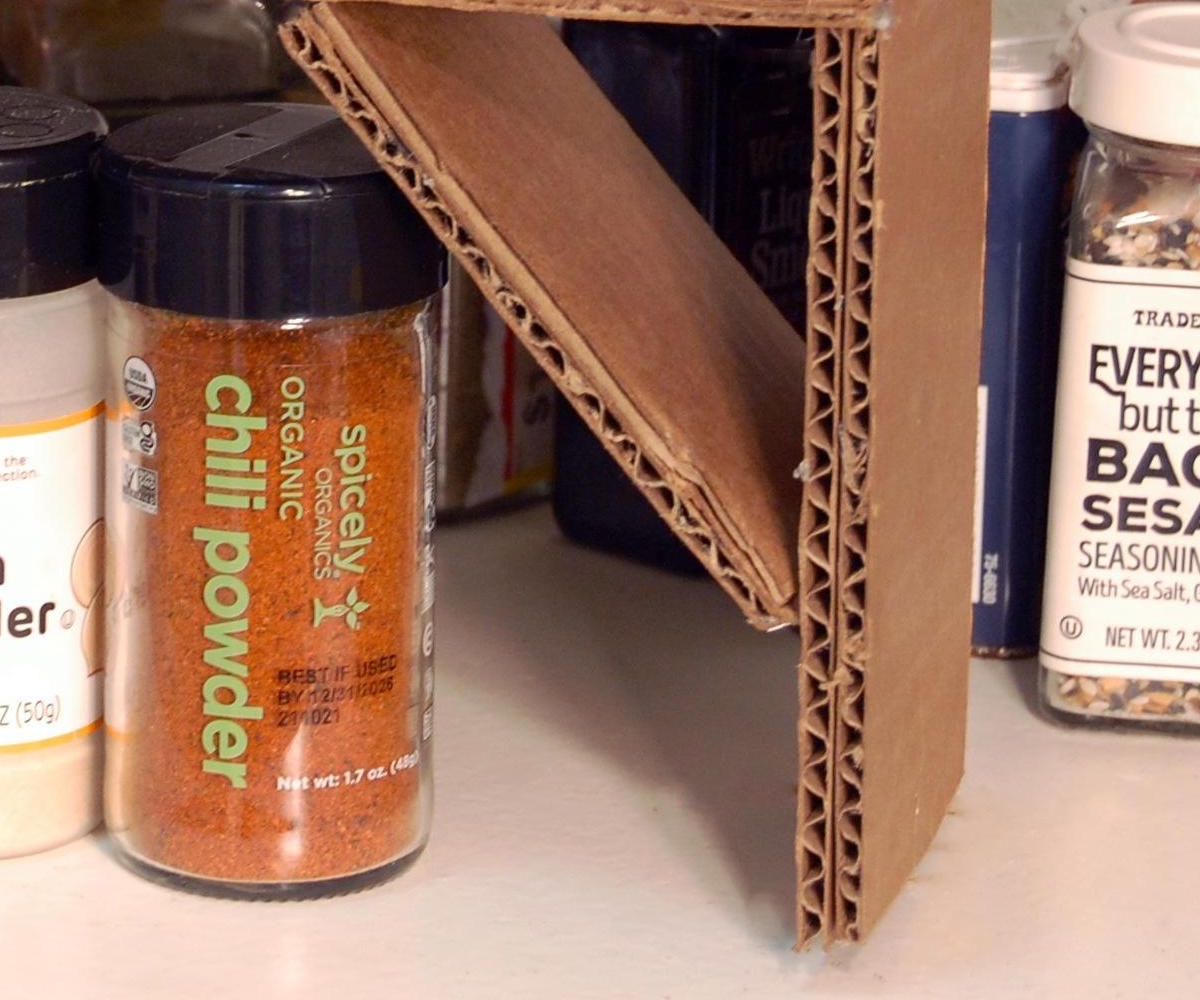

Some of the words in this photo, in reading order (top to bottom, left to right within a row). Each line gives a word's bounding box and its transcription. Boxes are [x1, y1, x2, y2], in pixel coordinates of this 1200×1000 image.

[1134, 310, 1200, 329] TRADE
[1119, 391, 1180, 434] but
[204, 374, 268, 511] chili
[278, 375, 306, 521] ORGANIC
[4, 455, 27, 467] the
[332, 423, 367, 574] spicely
[313, 467, 333, 581] ORGANICS
[1078, 576, 1118, 598] With
[1121, 579, 1150, 599] Sea
[1154, 580, 1191, 605] Salt,
[1105, 626, 1136, 648] NET
[1141, 628, 1171, 650] WT.
[193, 525, 264, 789] powder
[278, 667, 329, 684] BEST
[335, 666, 350, 681] IF
[356, 654, 397, 677] USED
[16, 696, 61, 728] (50g)
[277, 690, 303, 705] BY
[277, 776, 309, 791] Net
[314, 773, 340, 789] wt:
[343, 769, 364, 785] 1.7
[368, 765, 388, 781] oz.
